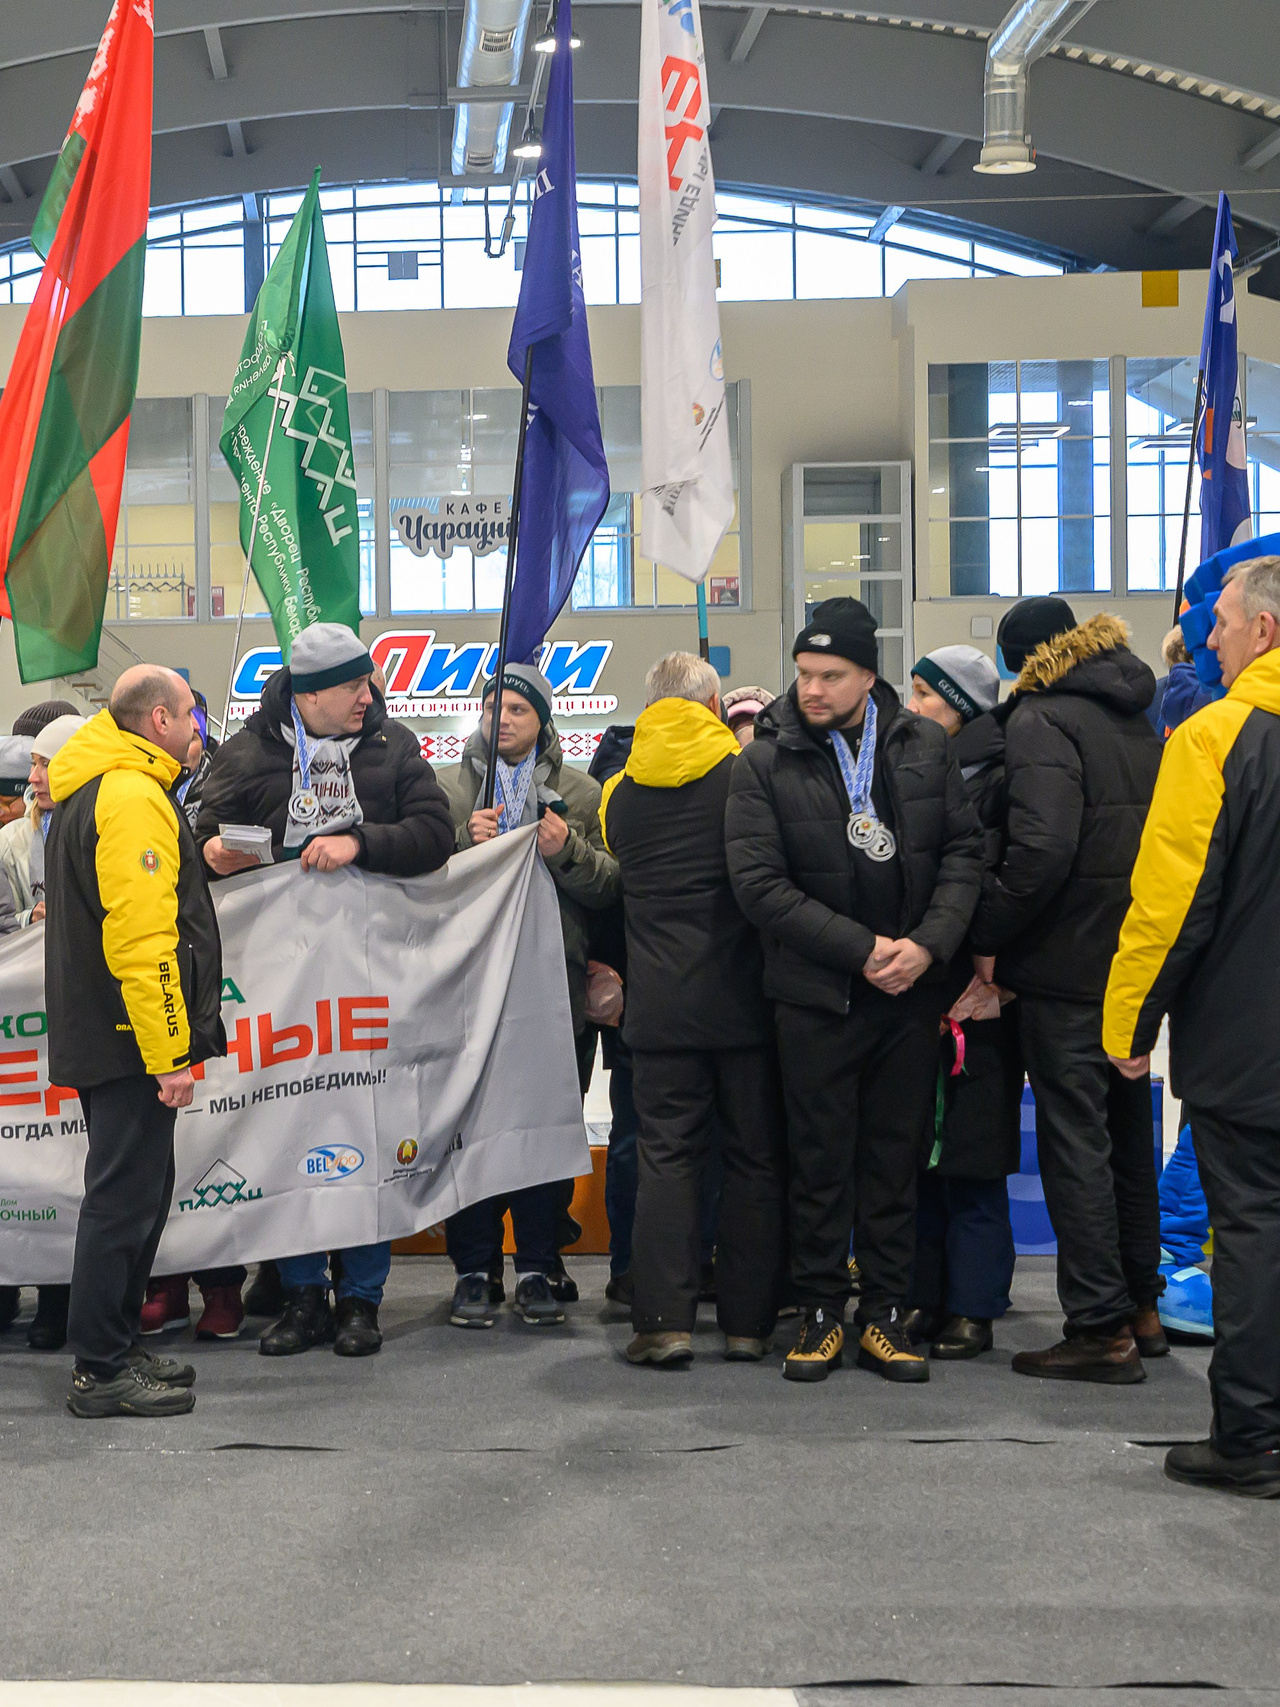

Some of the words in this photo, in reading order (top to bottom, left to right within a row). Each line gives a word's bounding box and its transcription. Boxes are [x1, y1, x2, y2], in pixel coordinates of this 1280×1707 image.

[446, 501, 502, 515] КАФЕ
[159, 961, 179, 1037] BELARUS
[209, 1094, 246, 1115] МЫ
[251, 1069, 388, 1105] НЕПОБЕДИМЫ!
